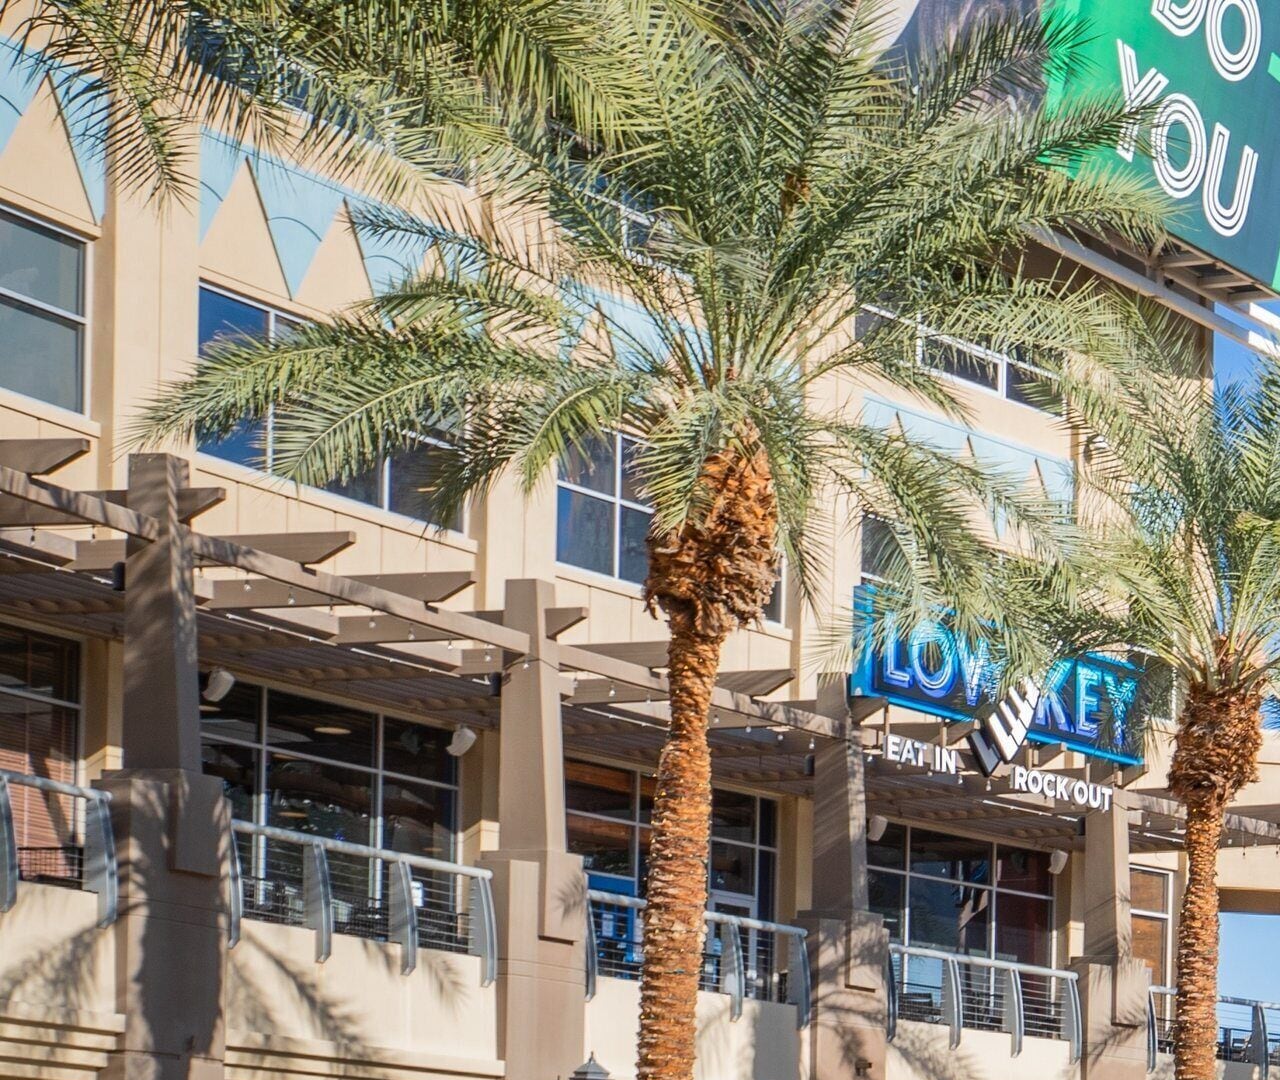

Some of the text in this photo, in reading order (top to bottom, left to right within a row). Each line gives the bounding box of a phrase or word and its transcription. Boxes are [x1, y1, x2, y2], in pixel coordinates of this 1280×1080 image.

[1116, 38, 1259, 238] YOU
[1033, 656, 1138, 750] KEY
[885, 734, 956, 775] EAT IN
[1011, 766, 1113, 812] ROCK OUT
